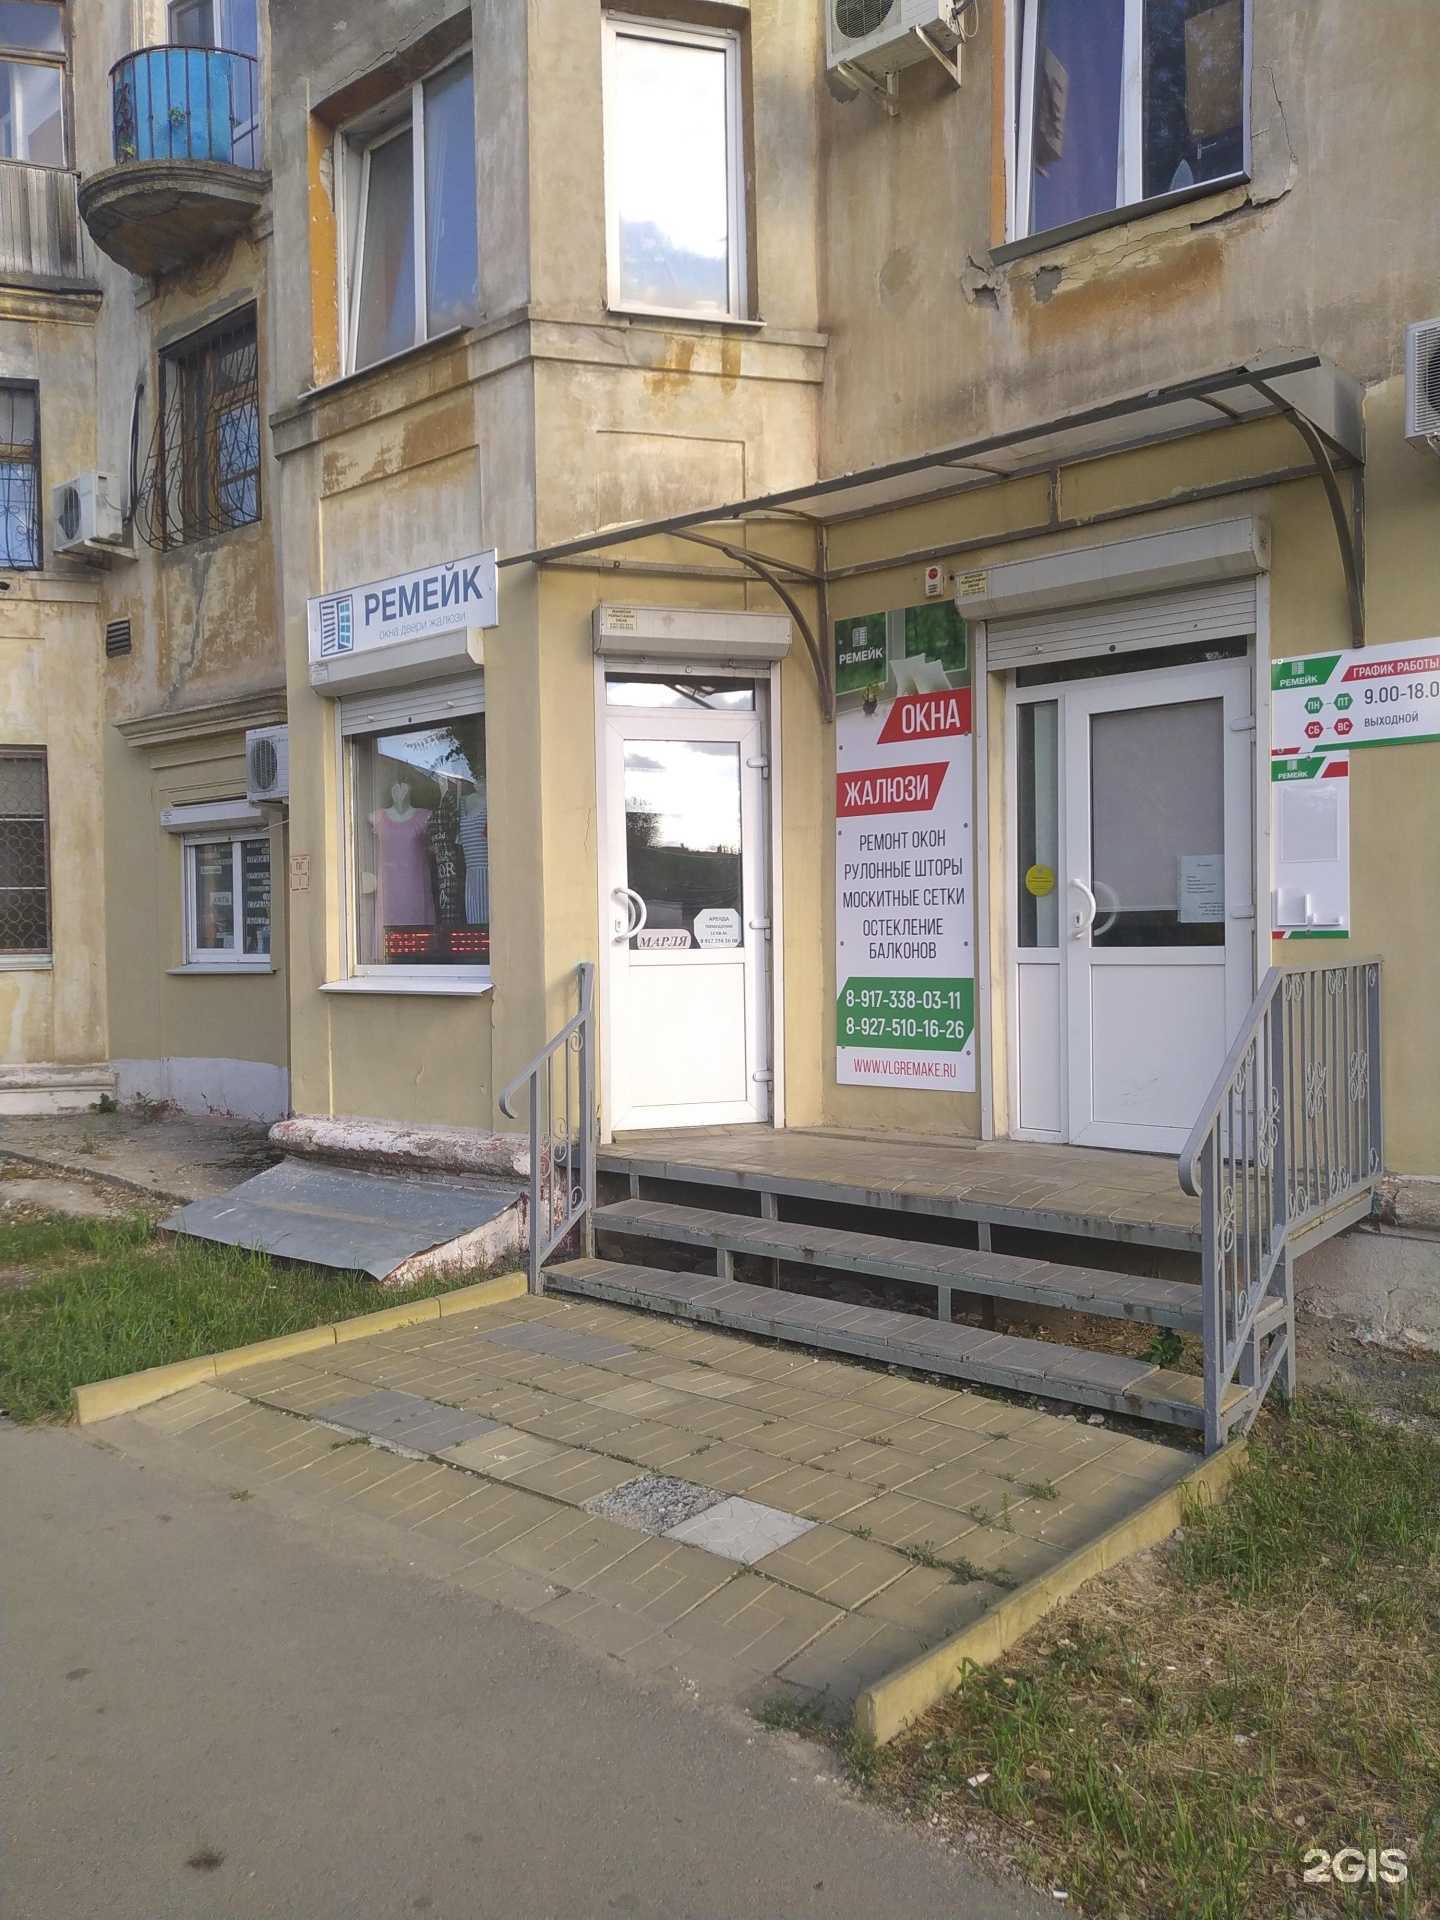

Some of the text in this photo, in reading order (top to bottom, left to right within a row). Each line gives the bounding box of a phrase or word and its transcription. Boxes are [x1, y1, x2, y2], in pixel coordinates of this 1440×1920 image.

[364, 562, 483, 626] РЕМЕЙК
[839, 647, 884, 665] РЕМЕЙК
[1353, 657, 1440, 678] ГРАФИК РАБОТЫ
[1280, 674, 1318, 687] РЕМЕЙК
[1307, 701, 1320, 710] ПН
[1337, 697, 1350, 707] ПТ
[902, 699, 960, 734] ОКНА
[1307, 711, 1419, 734] СБ ВС ВЫХОДНОЙ
[1278, 770, 1308, 780] РЕМЕЙК
[844, 774, 929, 807] ЖАЛЮЗИ
[860, 829, 946, 851] РЕМОНТ ОКОН
[844, 857, 963, 881] РУЛОННЫЕ ШТОРЫ
[843, 887, 965, 908] МОСКИТНЫЕ СЕТКИ
[862, 918, 943, 937] ОСТЕКЛЕНИЕ
[639, 936, 687, 947] МАРЛЯ
[869, 941, 937, 959] БАЛКОНОВ
[846, 990, 961, 1010] 8-917-338-03-11
[846, 1018, 964, 1039] 8-927-510-16-26
[853, 1057, 957, 1078] WWW.VLGREMAKE.RU
